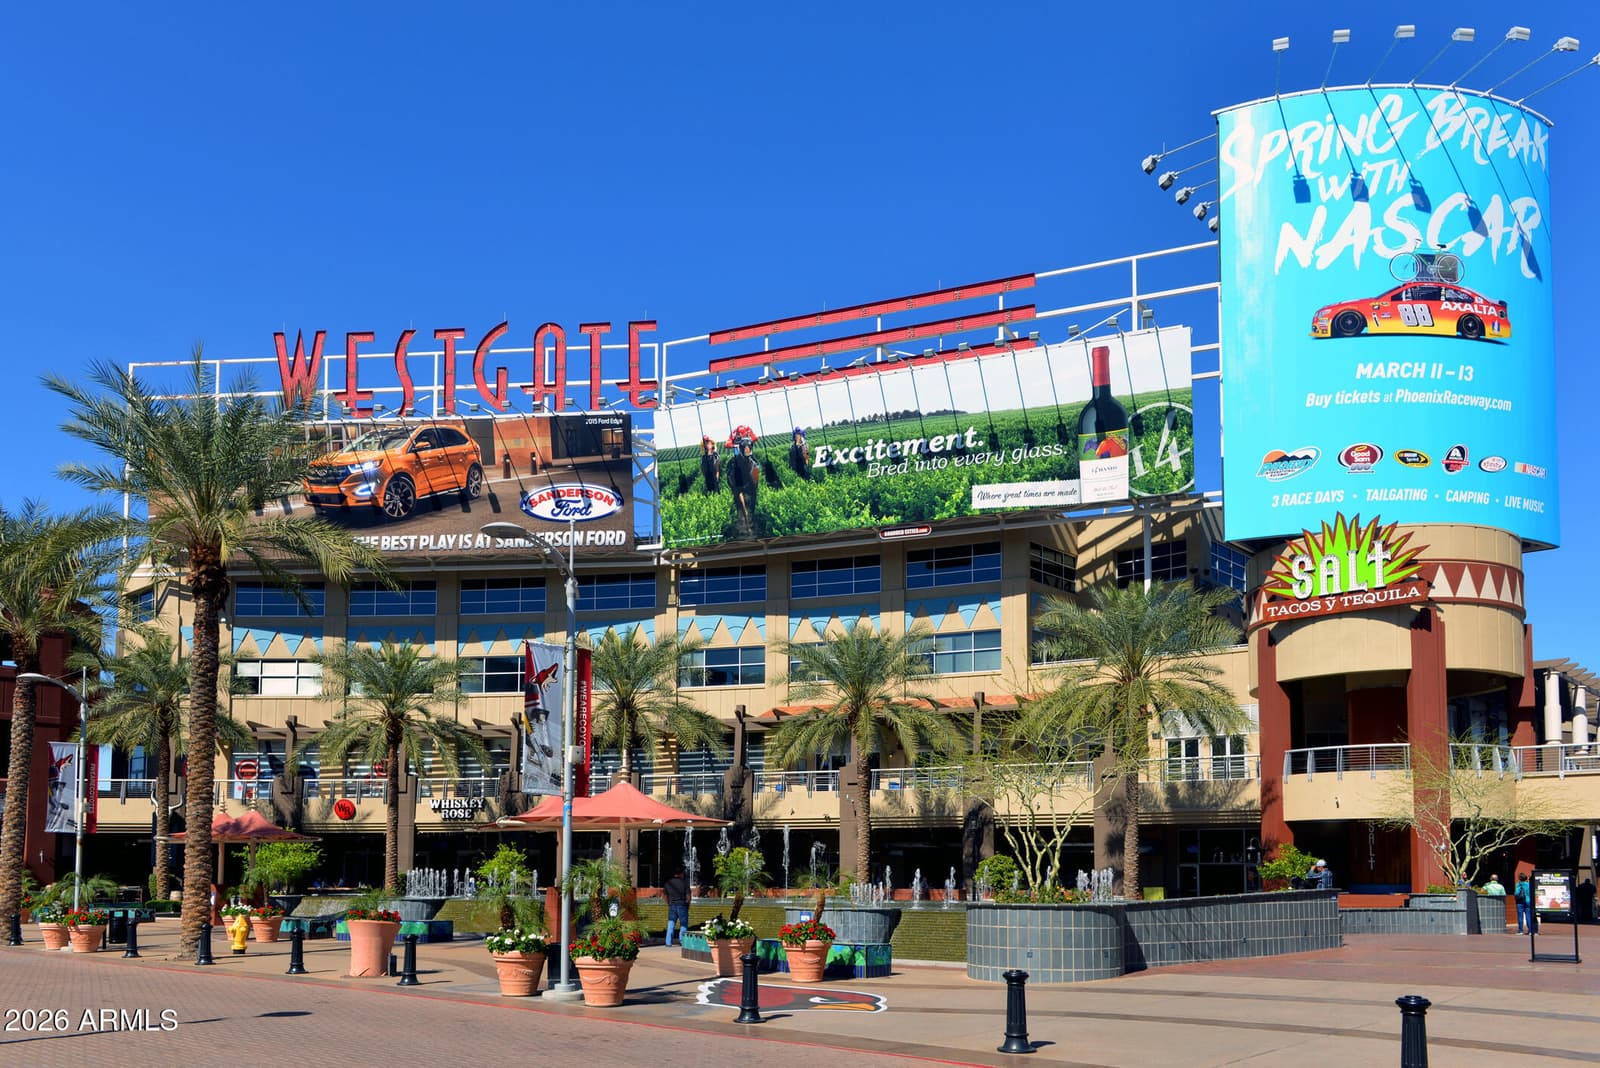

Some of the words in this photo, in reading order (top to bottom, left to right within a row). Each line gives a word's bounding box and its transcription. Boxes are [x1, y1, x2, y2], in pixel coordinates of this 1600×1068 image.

[1416, 91, 1549, 172] BREAK
[1274, 191, 1541, 278] NASCAR
[1398, 304, 1434, 327] 88
[1441, 301, 1497, 317] AXALTA
[273, 320, 658, 418] WESTGATE
[1355, 362, 1426, 379] MARCH
[1458, 365, 1474, 381] 13
[1306, 393, 1332, 408] Buy
[1335, 390, 1381, 405] tickets
[1383, 392, 1393, 403] at
[1395, 389, 1512, 411] PhoenixRaceway.com
[812, 426, 984, 469] Excitement.
[1129, 409, 1190, 480] 14
[867, 461, 908, 478] Bred
[915, 455, 948, 473] into
[954, 451, 1006, 467] every
[1012, 443, 1068, 465] glass.
[529, 489, 615, 508] SANDERSON
[976, 490, 1002, 500] Where
[1002, 491, 1021, 503] great
[1023, 489, 1041, 498] times
[1057, 488, 1078, 496] made
[1272, 495, 1279, 508] 3
[1281, 491, 1312, 506] RACE
[1315, 490, 1344, 504] DAYS
[1366, 488, 1428, 501] TAILGATING
[1446, 490, 1490, 504] CAMPING
[1505, 496, 1521, 509] LIVE
[1522, 498, 1545, 513] MUSIC
[550, 499, 592, 517] Ford
[381, 535, 417, 550] BEST
[419, 534, 457, 550] PLAY
[458, 533, 473, 549] IS
[585, 530, 626, 546] FORD
[1267, 601, 1321, 617] TACOS
[1340, 587, 1421, 607] TEQUILA
[579, 680, 587, 764] #WEARECOYO
[430, 799, 484, 809] WHISKEY
[441, 809, 472, 819] ROSE
